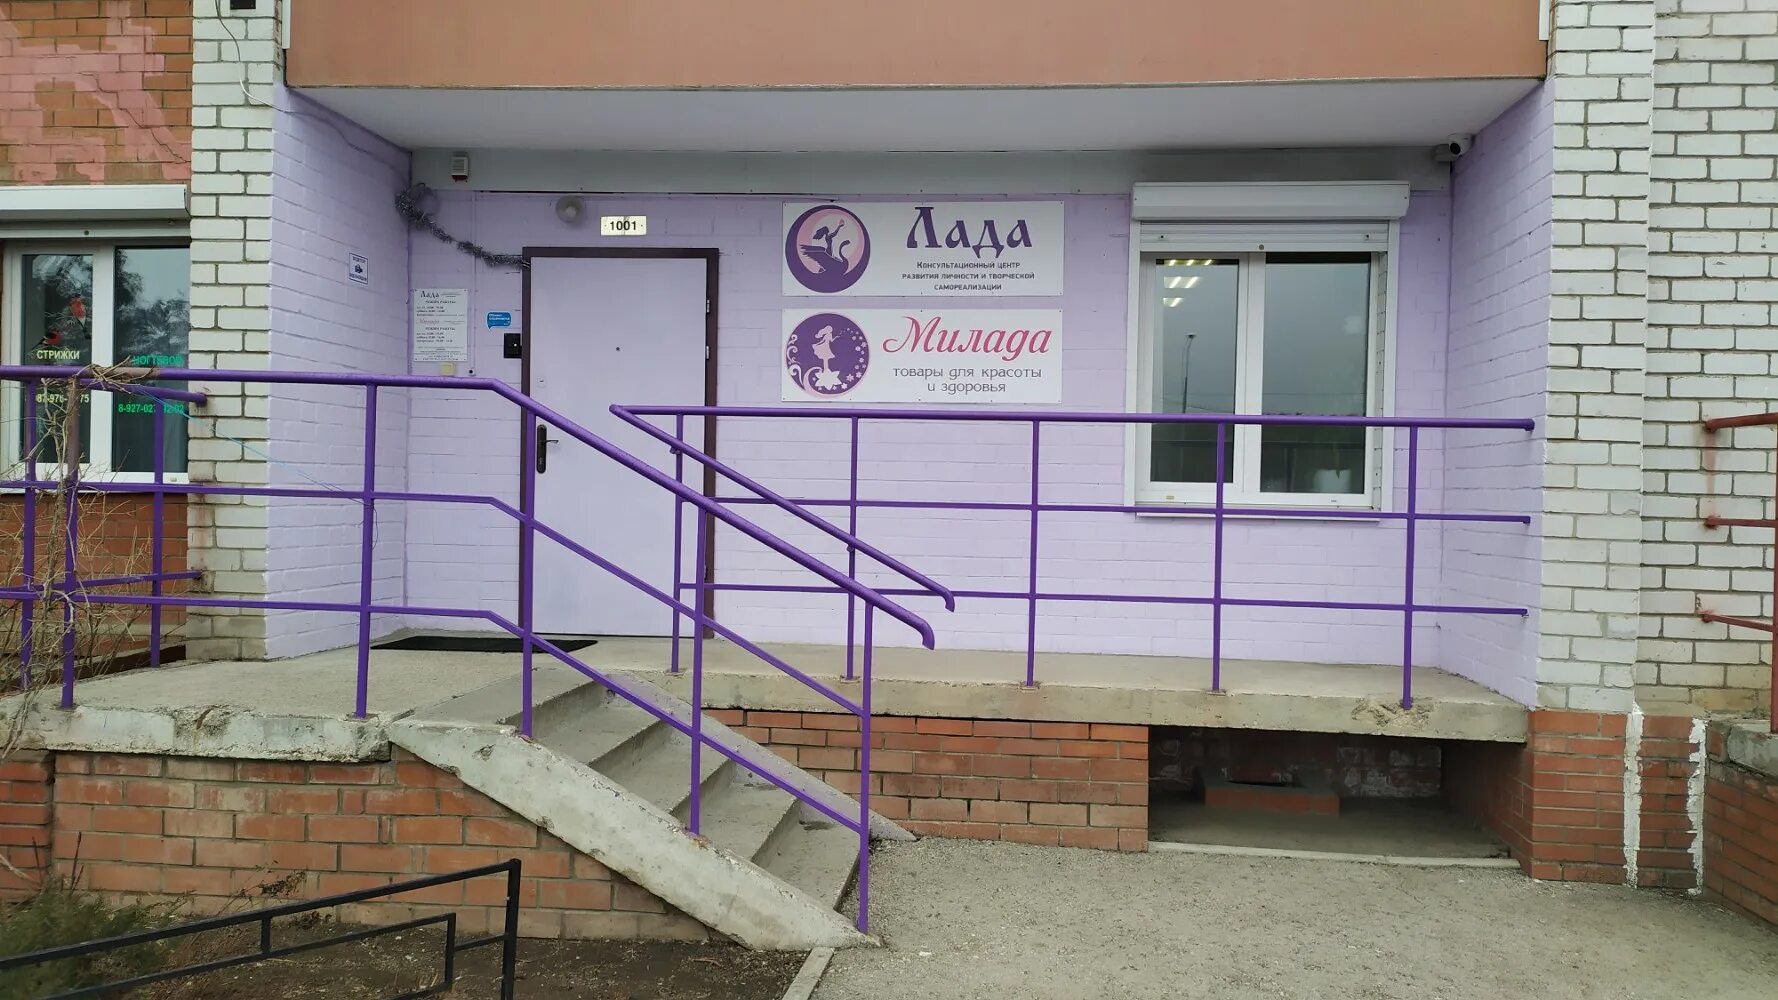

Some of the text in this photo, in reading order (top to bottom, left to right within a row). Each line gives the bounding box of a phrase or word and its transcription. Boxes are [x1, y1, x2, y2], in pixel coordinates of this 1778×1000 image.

[610, 220, 636, 231] 1001
[906, 206, 1033, 259] Лада
[989, 272, 1035, 280] ТВОРЧЕСКОЙ
[882, 315, 1053, 362] Милада
[37, 349, 80, 360] СТРИЖКИ
[893, 368, 1042, 381] товары для красоты
[927, 382, 1006, 395] и здоровья
